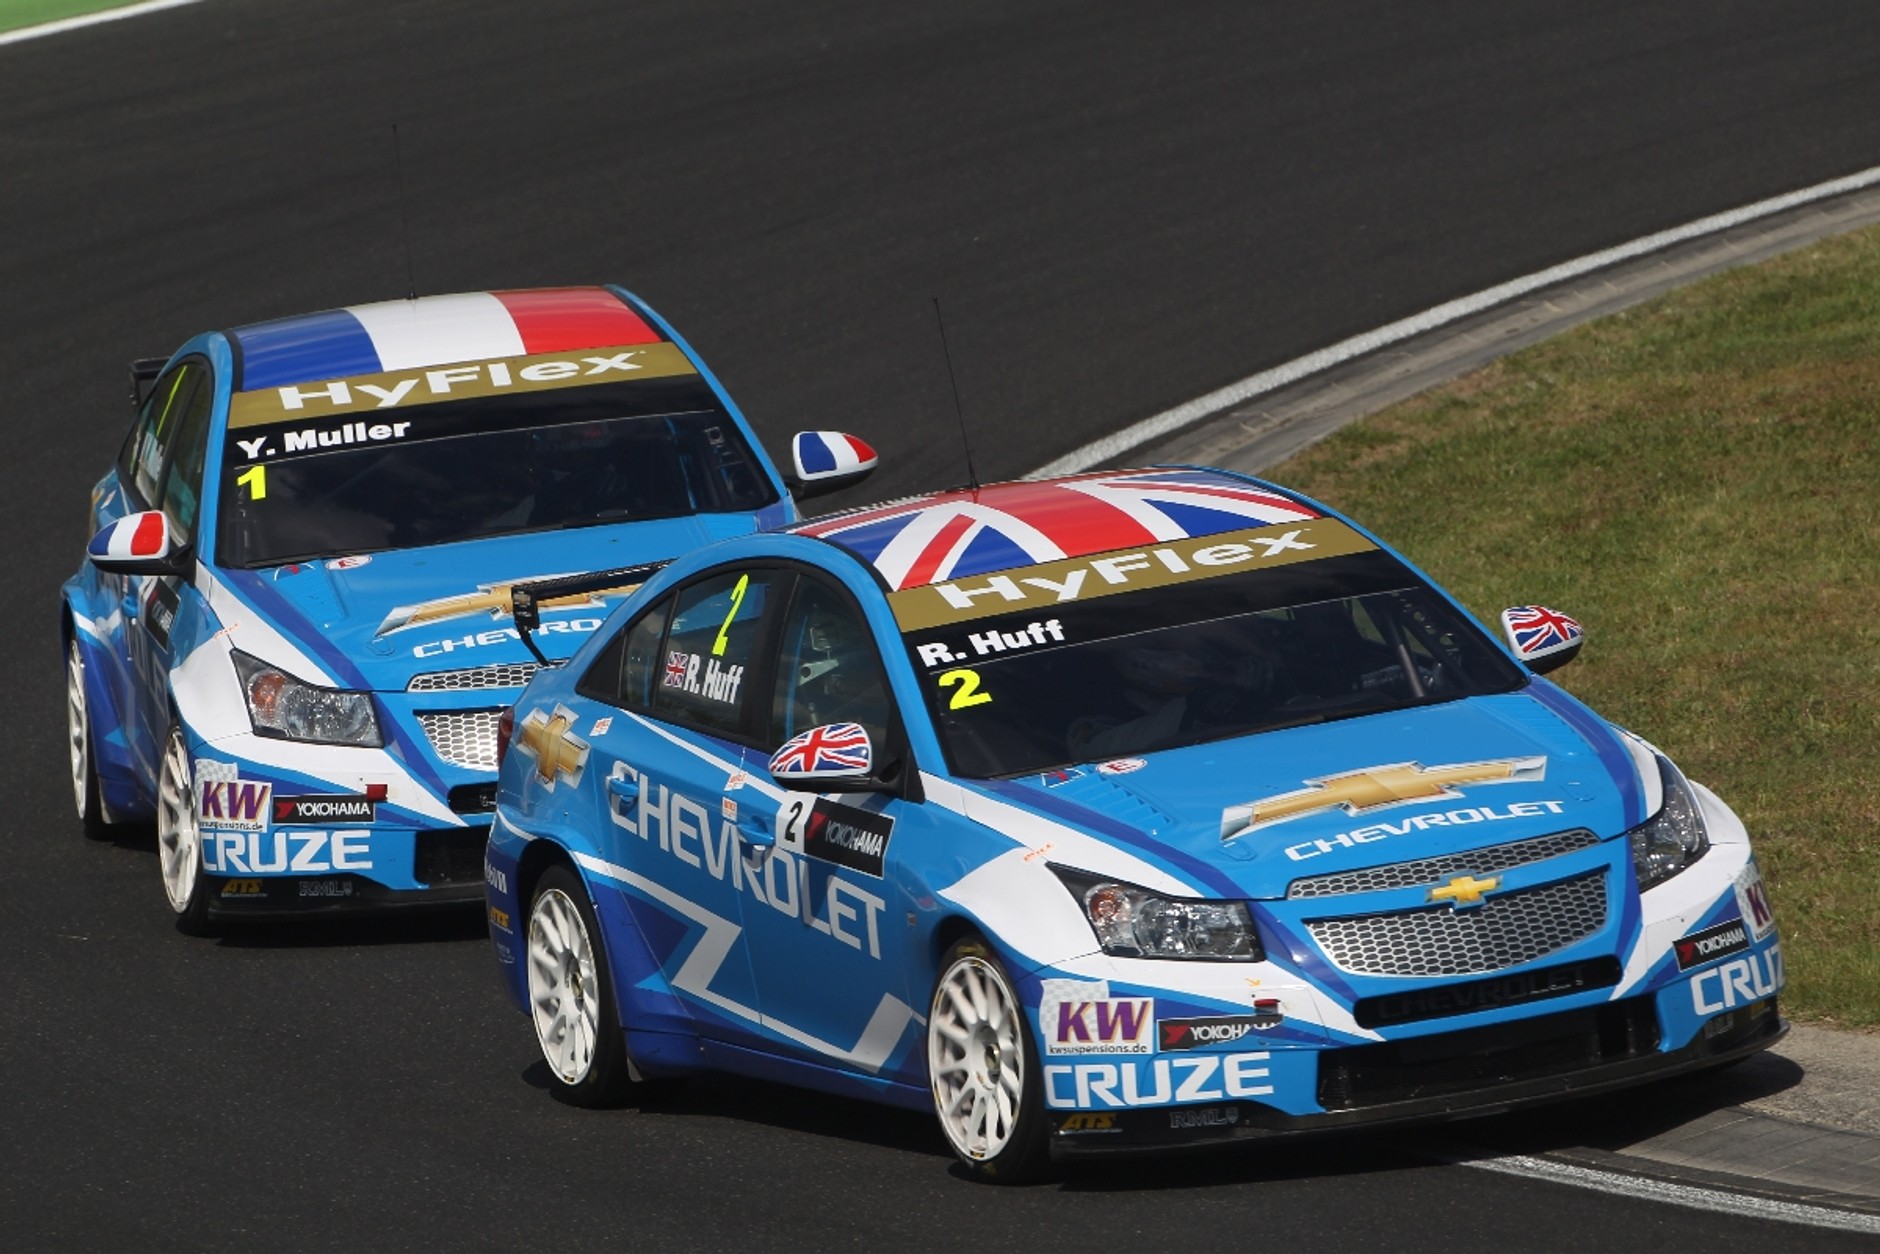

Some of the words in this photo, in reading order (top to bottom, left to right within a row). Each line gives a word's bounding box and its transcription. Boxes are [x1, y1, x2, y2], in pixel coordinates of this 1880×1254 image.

[278, 351, 642, 410] HyFlex
[236, 436, 275, 459] Y.
[284, 421, 411, 452] Muller
[237, 465, 266, 500] 1
[935, 529, 1317, 609] HyFlex
[712, 574, 748, 656] 2
[917, 643, 966, 668] R.
[970, 619, 1065, 655] Huff
[683, 653, 700, 694] R.
[702, 658, 744, 704] Huff
[938, 669, 993, 711] 2
[202, 780, 271, 822] KW
[296, 801, 371, 817] YOKOHAMA
[784, 801, 803, 842] 2
[824, 820, 884, 857] YOKOHAMA
[1284, 800, 1564, 862] CHEVROLET
[606, 760, 886, 961] CHEVROLET
[1694, 927, 1746, 956] YOKOHAMA
[1057, 1001, 1151, 1043] KW
[1049, 1043, 1148, 1055] kwsuspensions.de
[1043, 1051, 1275, 1108] CRUZE
